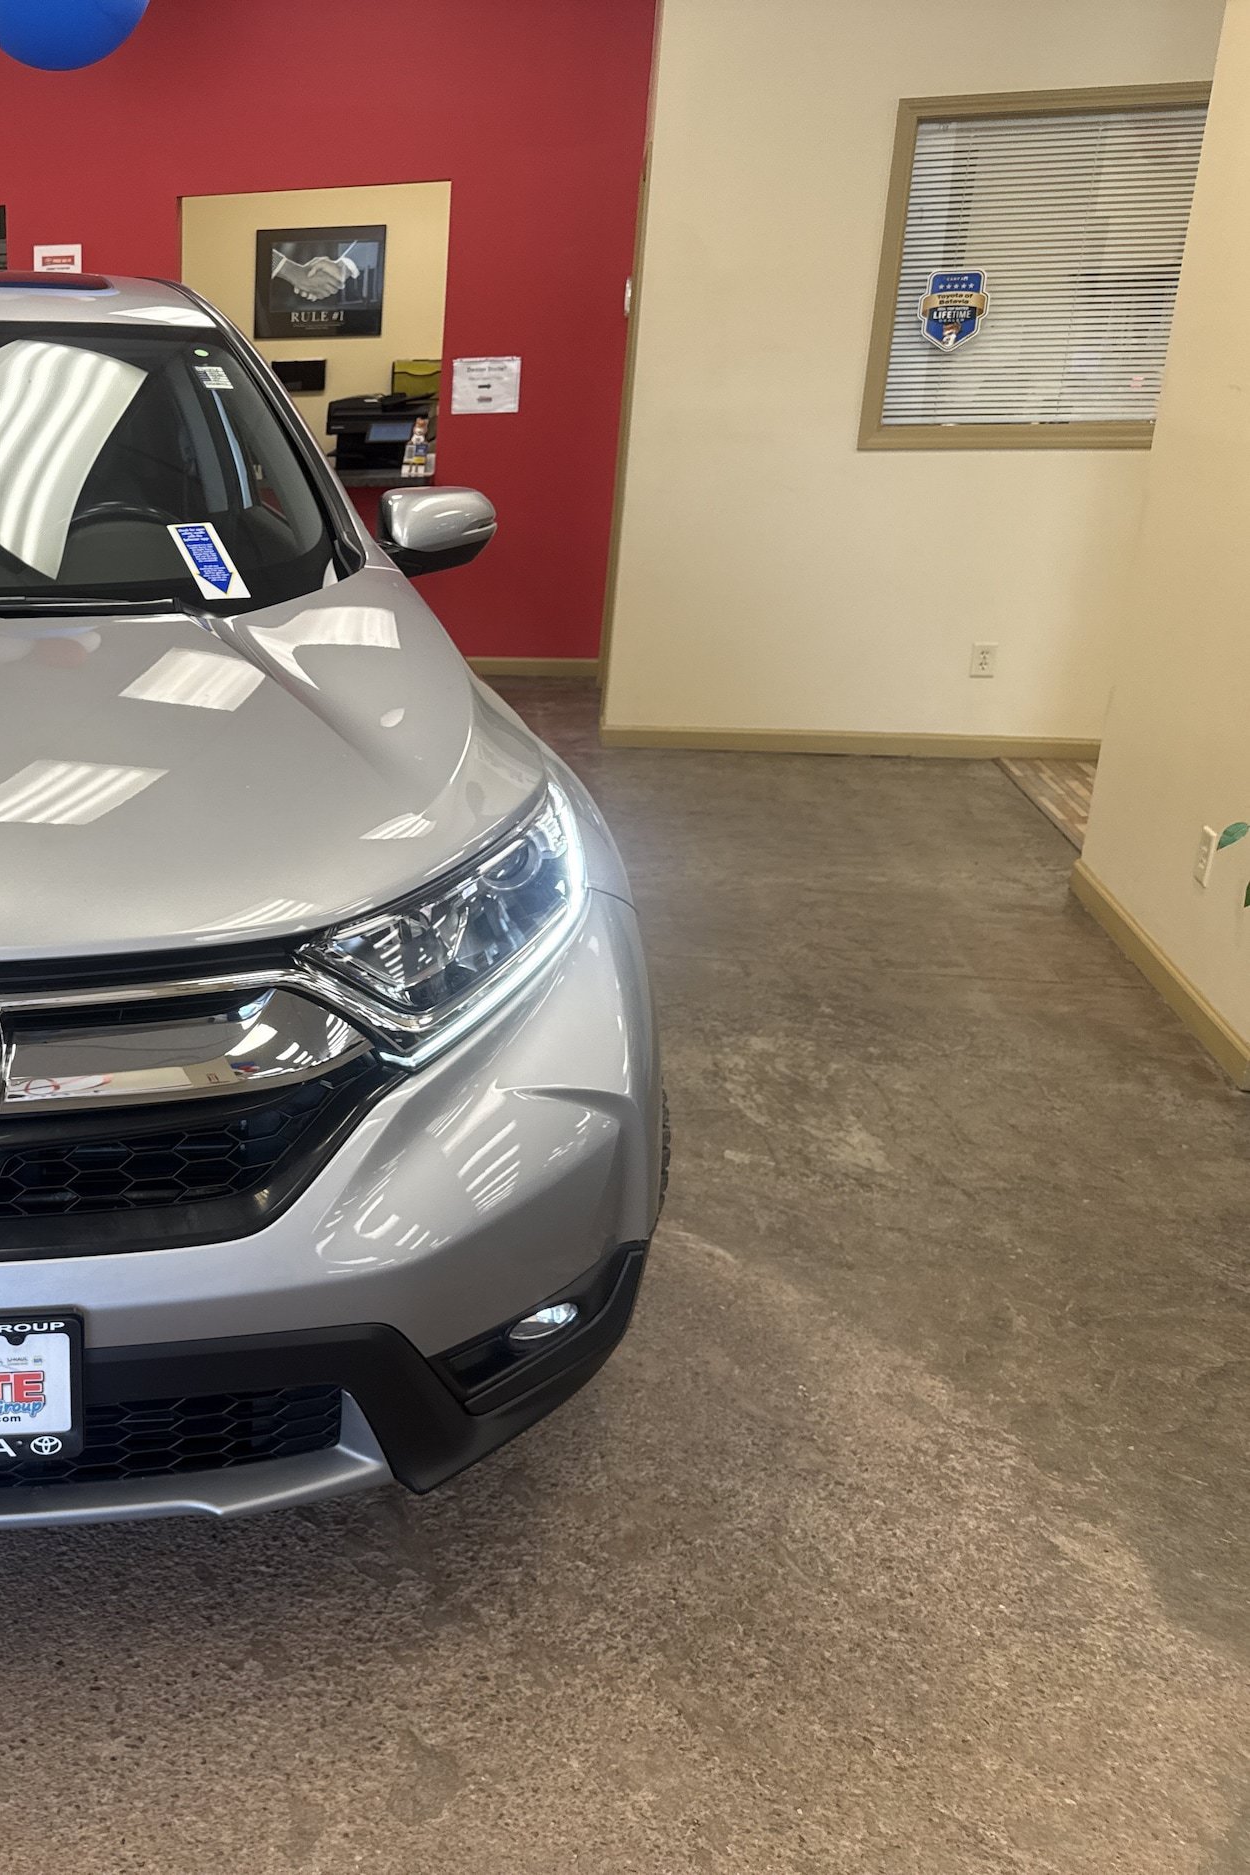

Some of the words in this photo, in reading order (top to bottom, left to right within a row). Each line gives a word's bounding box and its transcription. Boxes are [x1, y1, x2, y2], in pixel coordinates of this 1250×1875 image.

[291, 311, 330, 323] RULE
[332, 310, 345, 321] #1
[933, 310, 971, 319] LIFETIME
